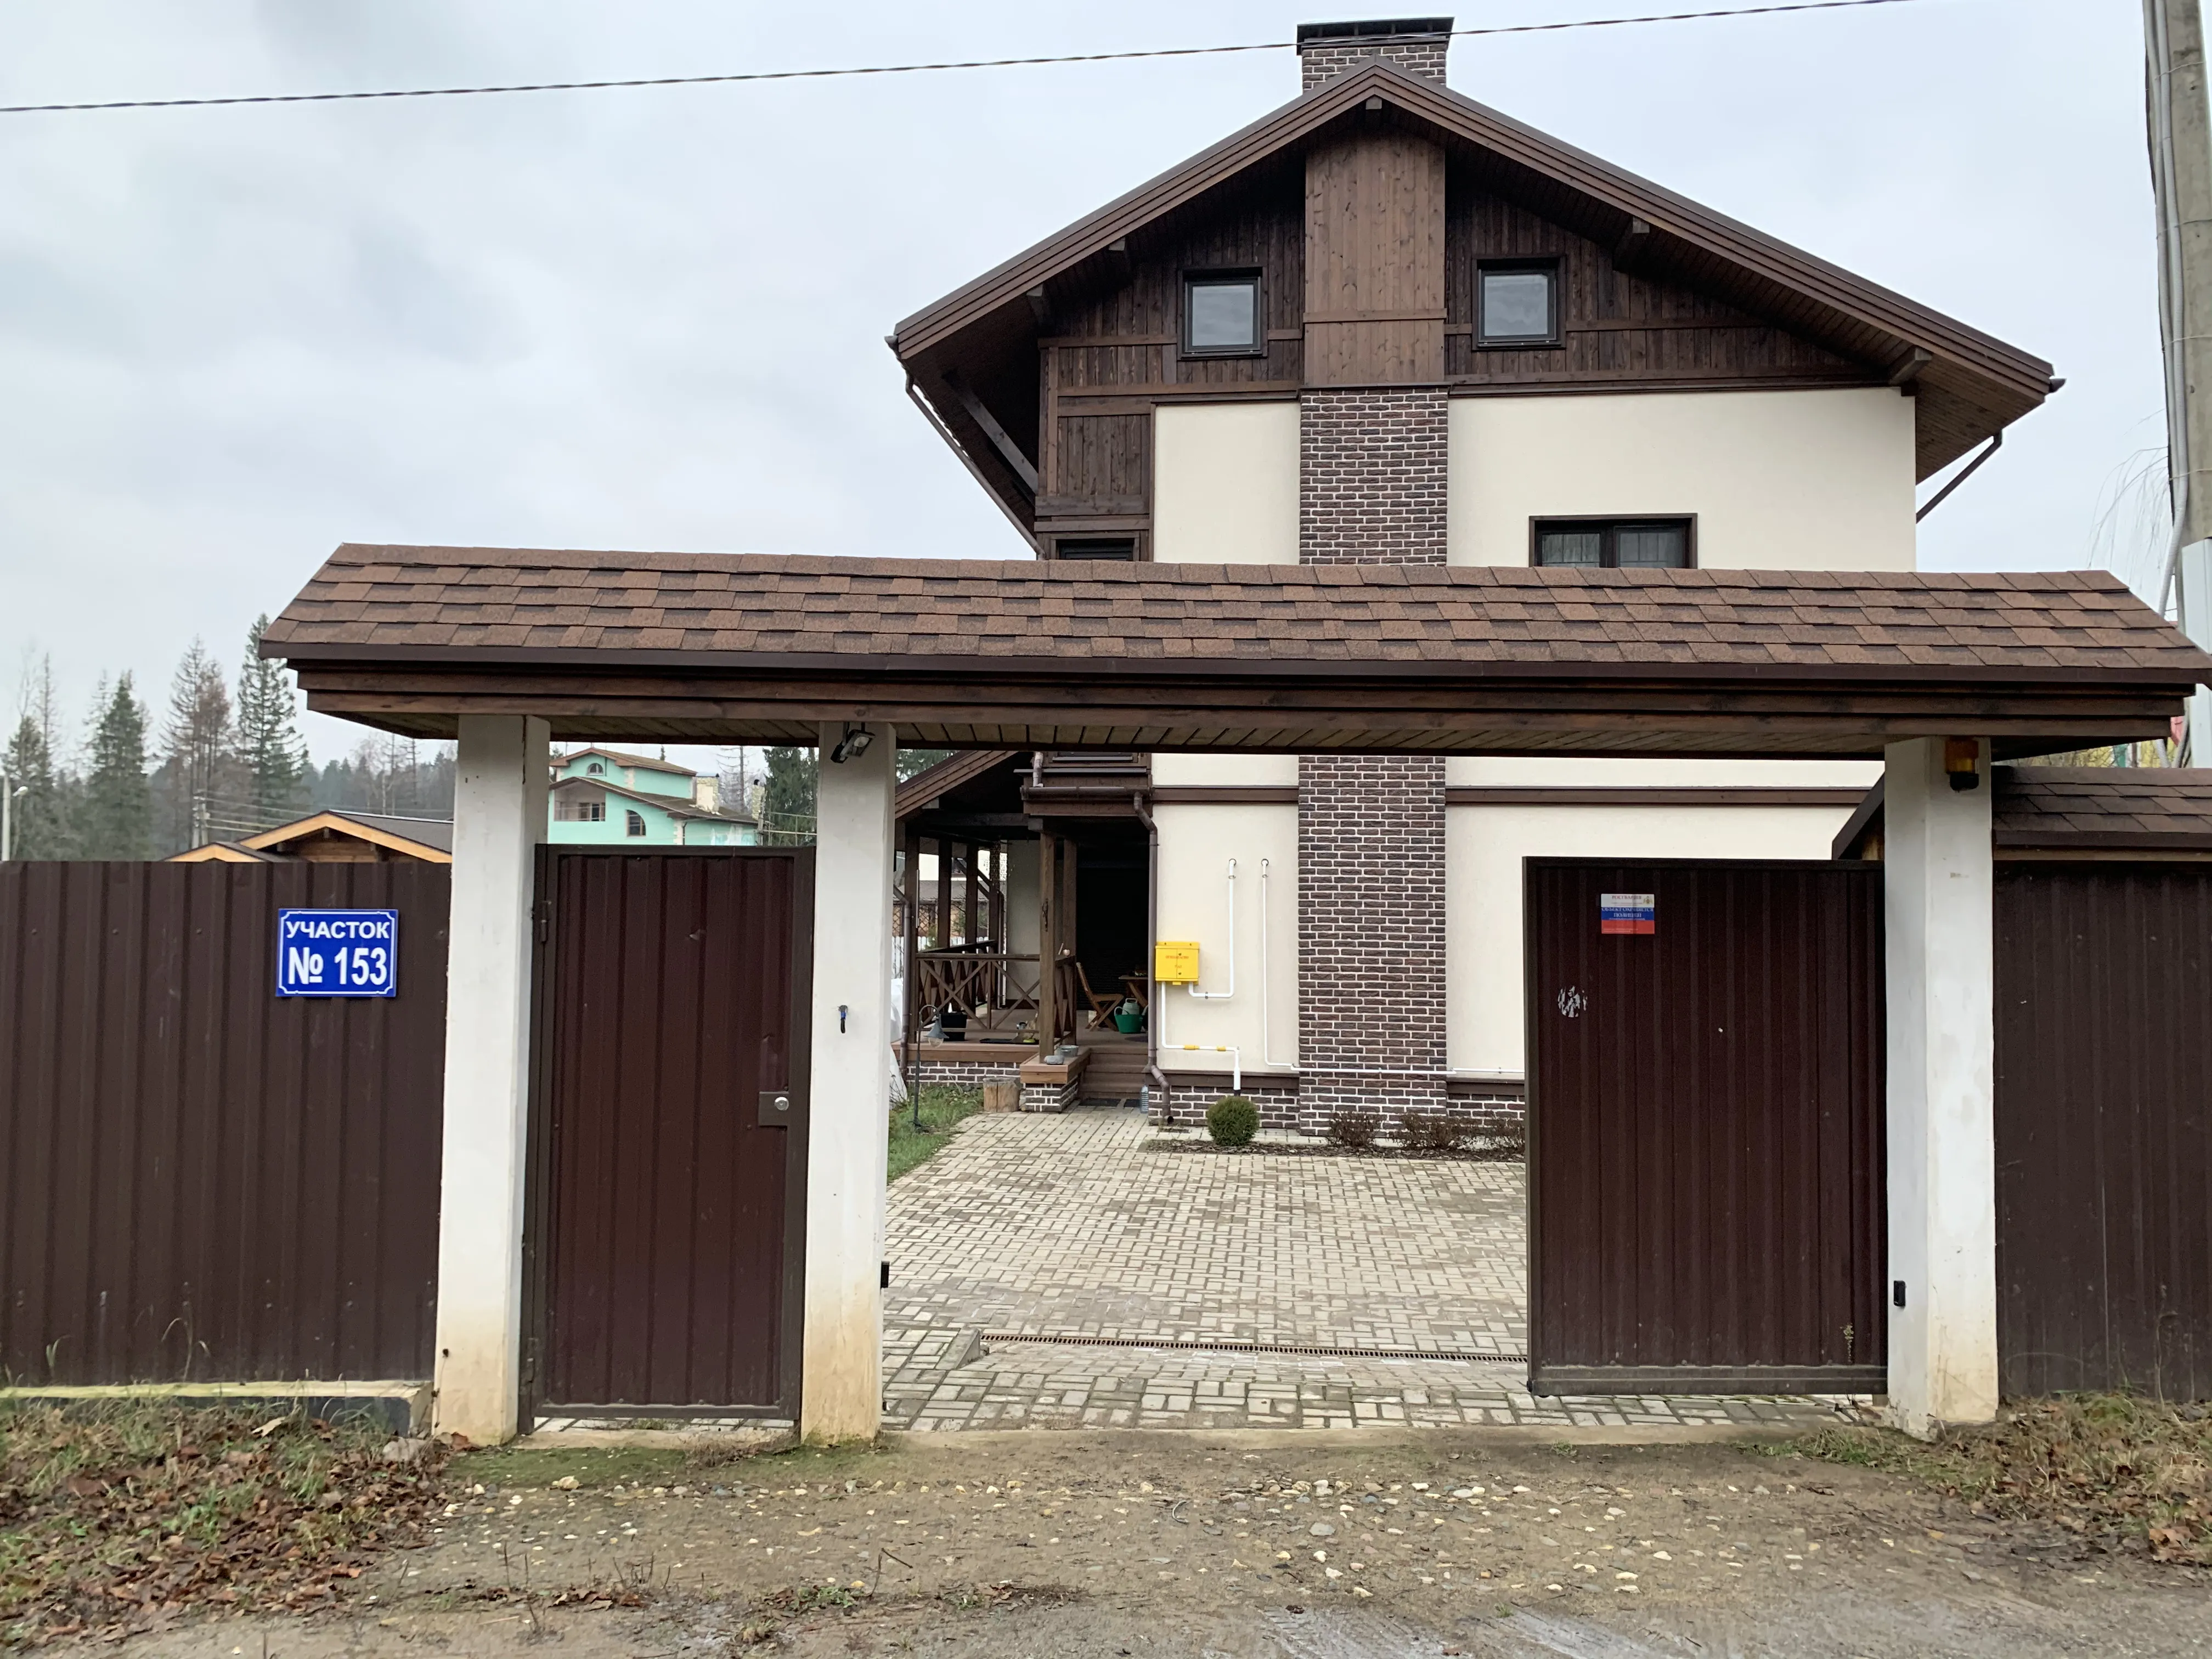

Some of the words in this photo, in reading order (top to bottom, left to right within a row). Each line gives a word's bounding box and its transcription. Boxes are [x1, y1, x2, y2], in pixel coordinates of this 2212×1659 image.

[285, 921, 390, 939] УЧАСТОК
[288, 947, 324, 984] №
[334, 947, 387, 985] 153
